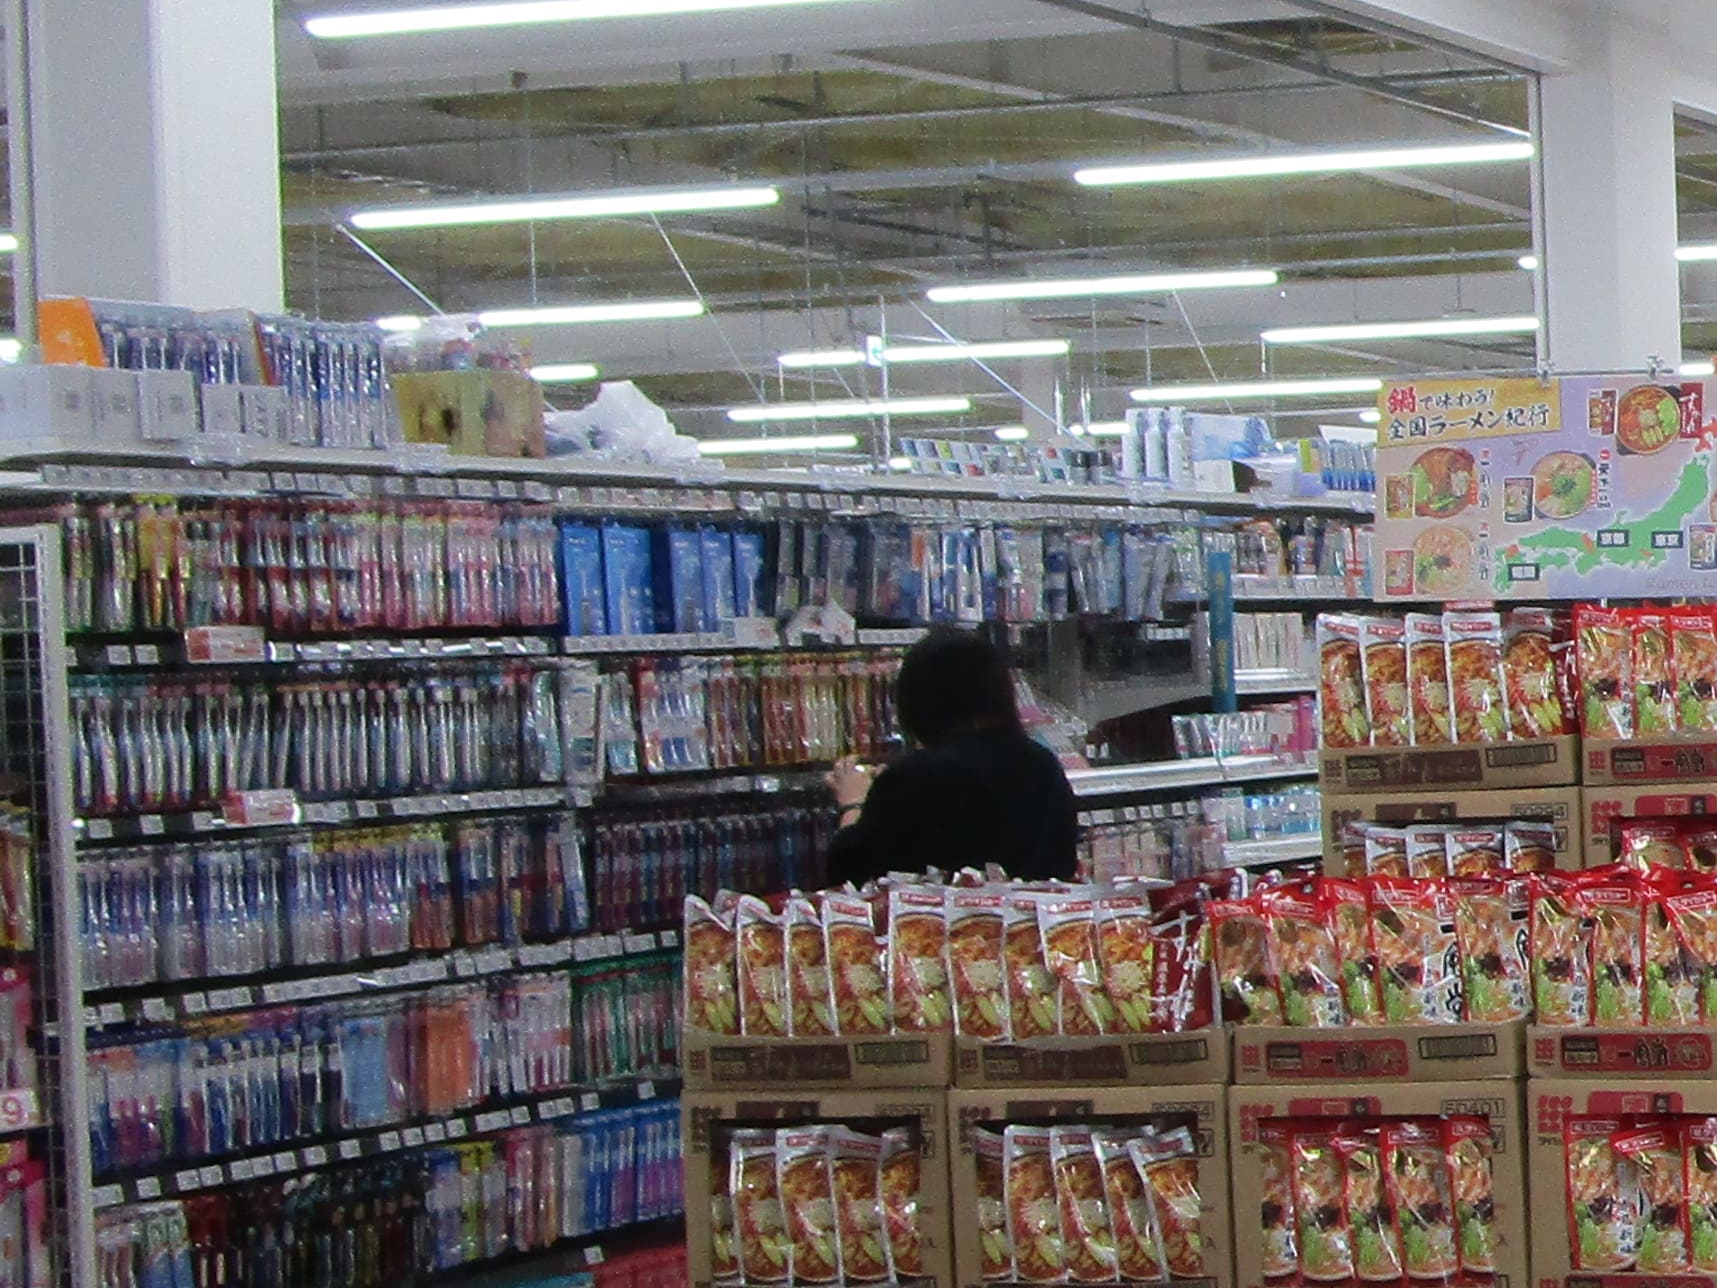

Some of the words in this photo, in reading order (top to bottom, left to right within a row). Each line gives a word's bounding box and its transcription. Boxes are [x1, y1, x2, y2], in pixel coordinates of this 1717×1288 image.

[1386, 386, 1495, 414] 鍋で味わう!
[1387, 404, 1550, 440] 全国ラーメン紀行
